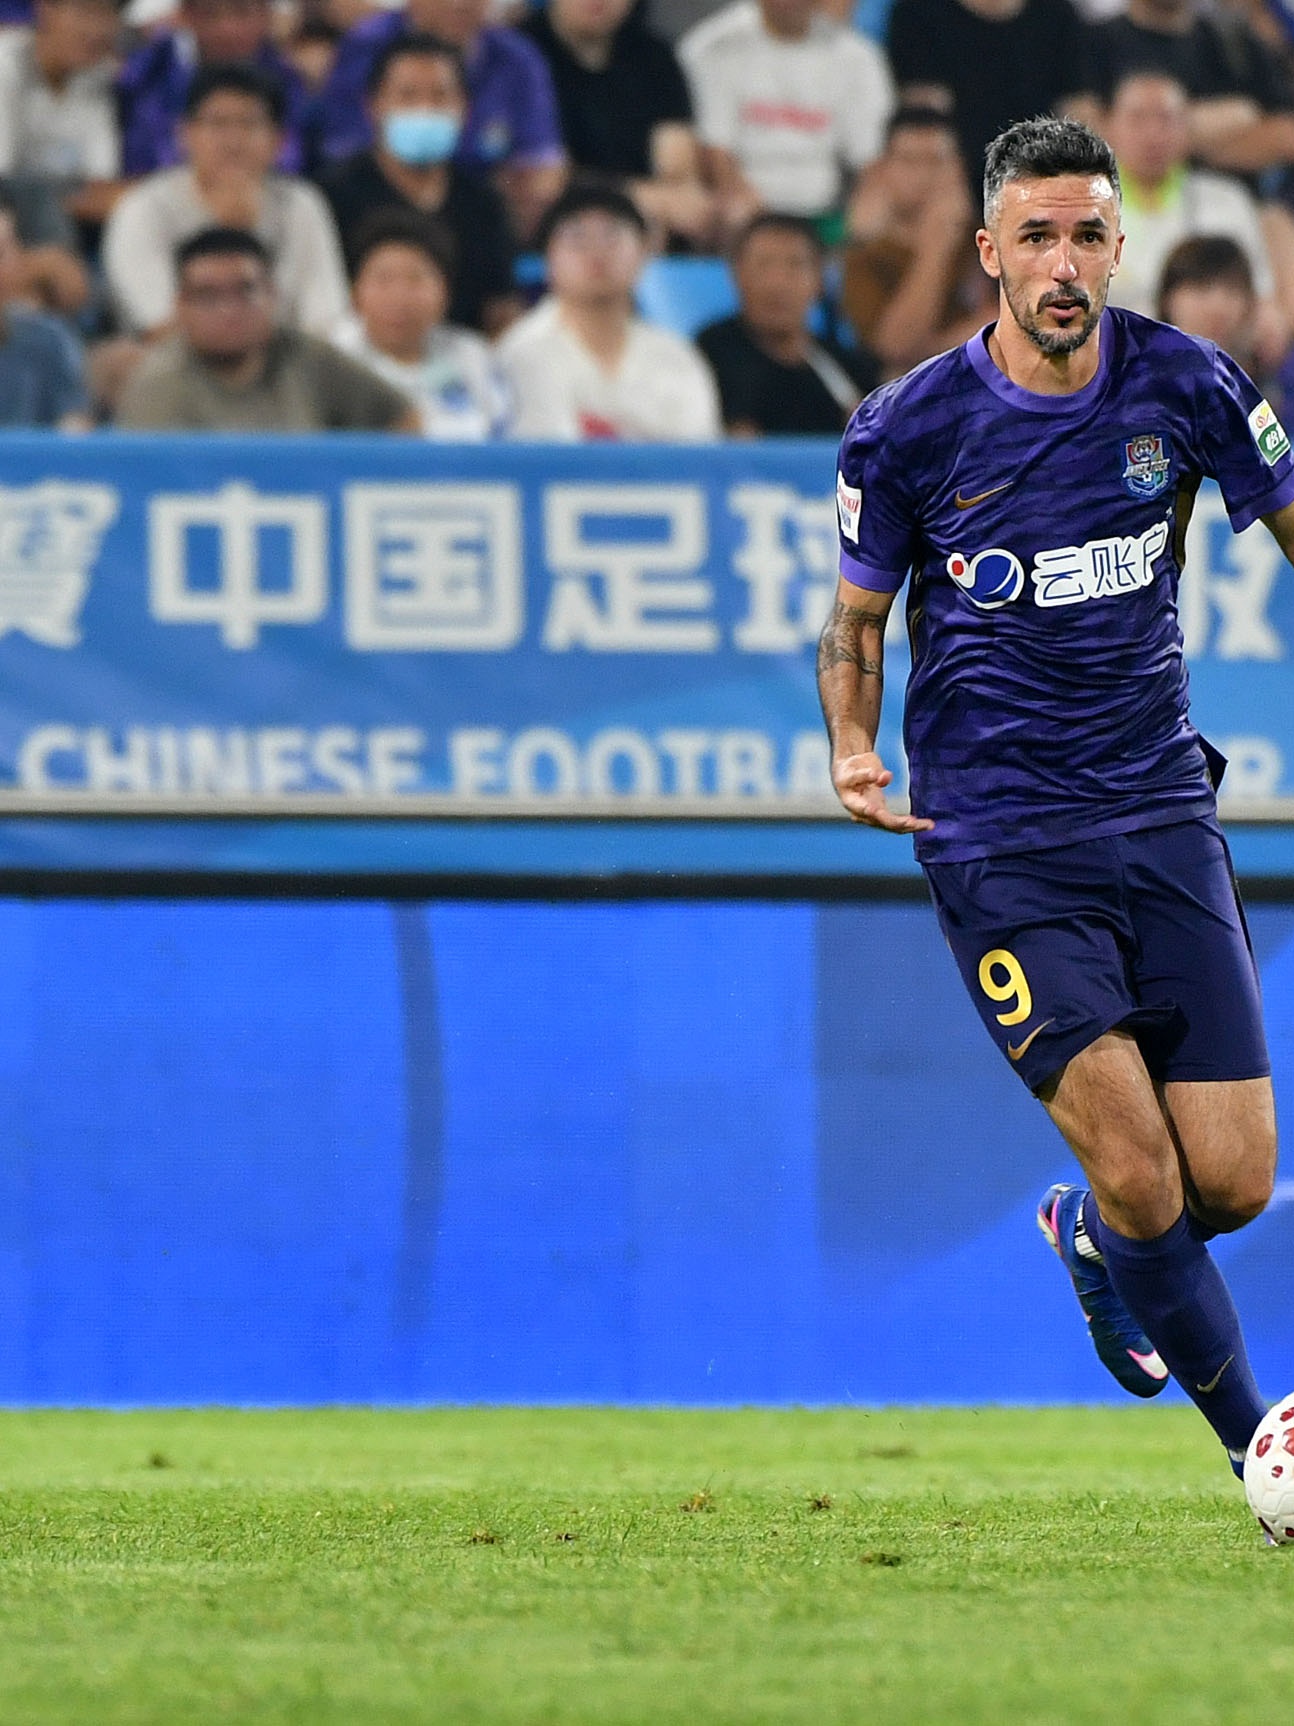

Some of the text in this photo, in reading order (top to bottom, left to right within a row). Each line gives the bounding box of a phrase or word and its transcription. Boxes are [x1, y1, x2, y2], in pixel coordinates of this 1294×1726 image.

[1034, 522, 1168, 606] 云账户
[18, 722, 428, 798] CHINESE
[449, 724, 832, 798] FOOTBA
[979, 949, 1031, 1026] 9
